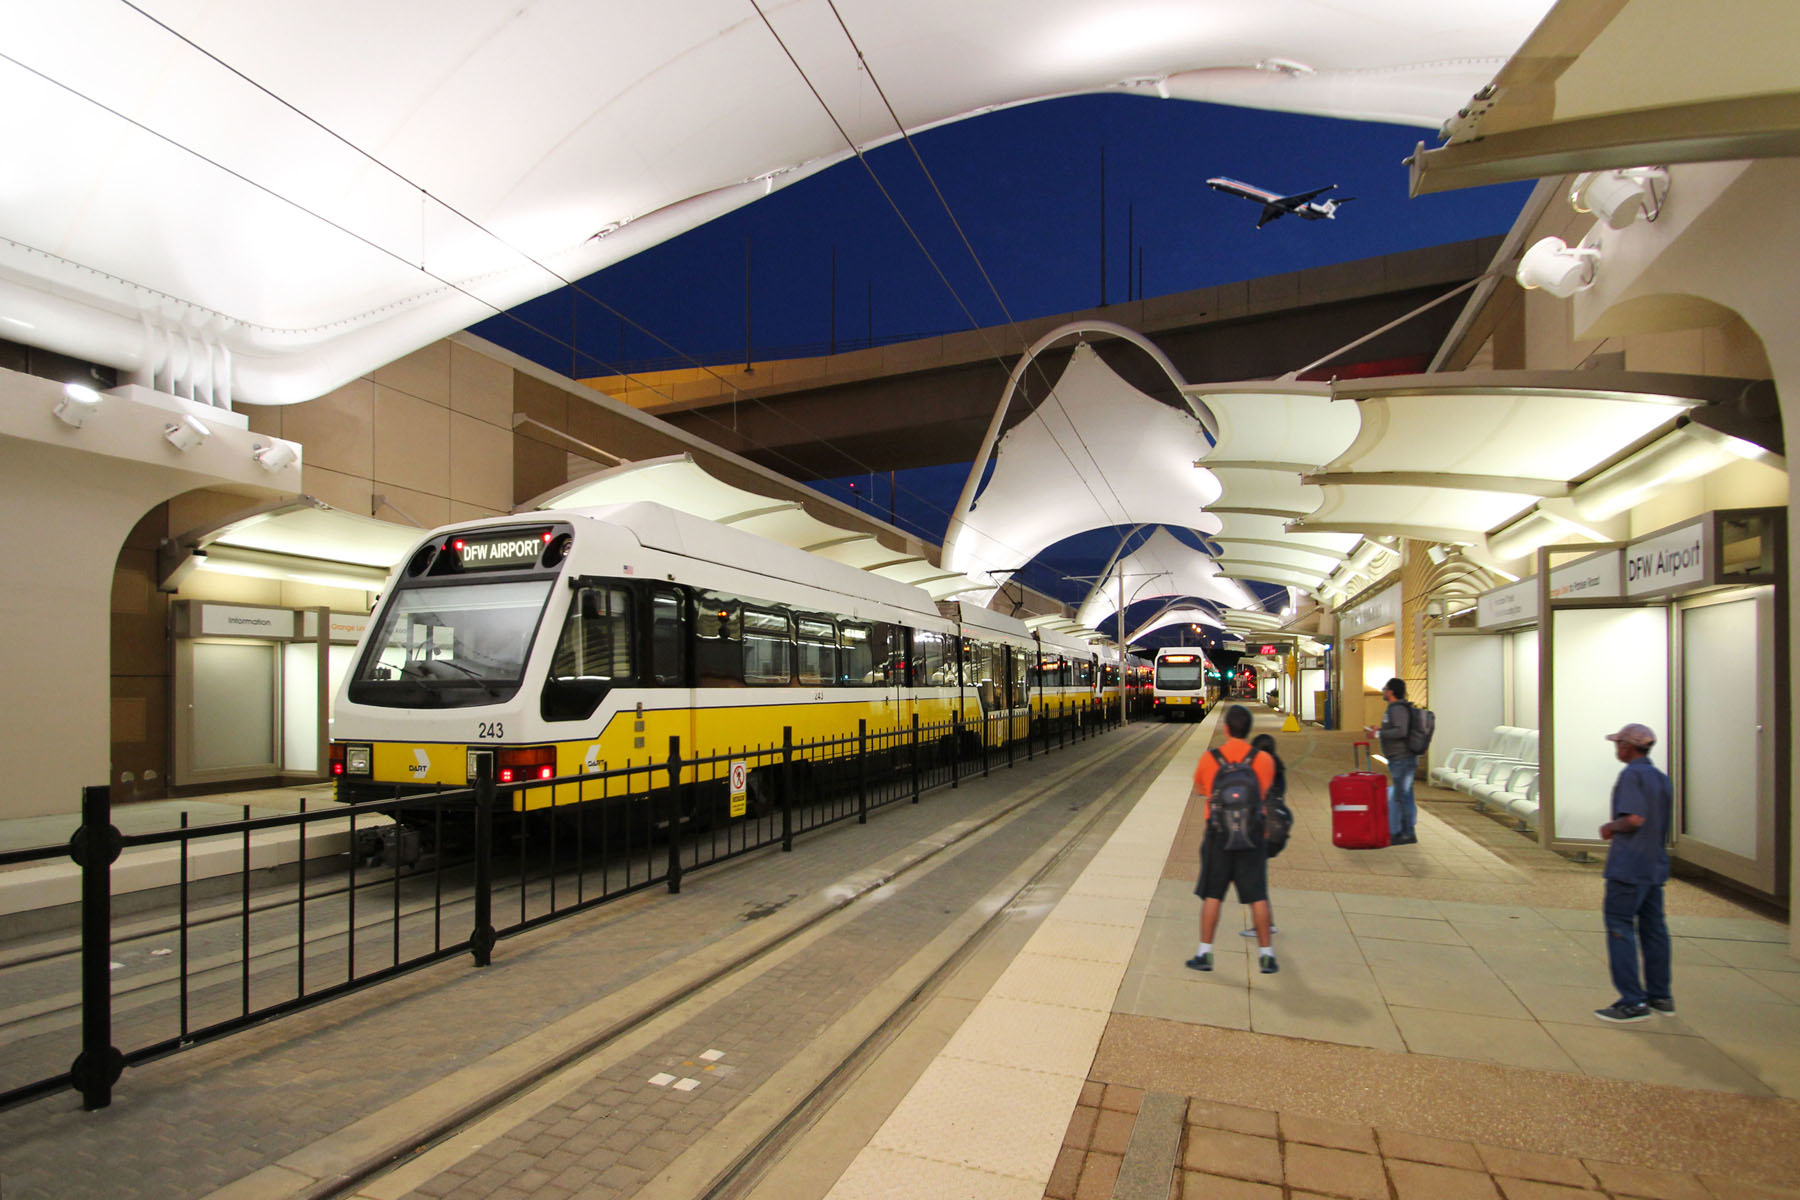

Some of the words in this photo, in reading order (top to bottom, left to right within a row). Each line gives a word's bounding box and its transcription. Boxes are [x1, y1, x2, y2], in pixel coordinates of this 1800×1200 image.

[463, 544, 488, 561] DFW
[490, 539, 540, 559] AIRPORT
[1628, 554, 1654, 581] DFW
[1656, 539, 1700, 576] Airport
[227, 616, 272, 626] Information
[331, 623, 356, 632] Orange
[478, 722, 504, 738] 243
[408, 764, 428, 772] DART
